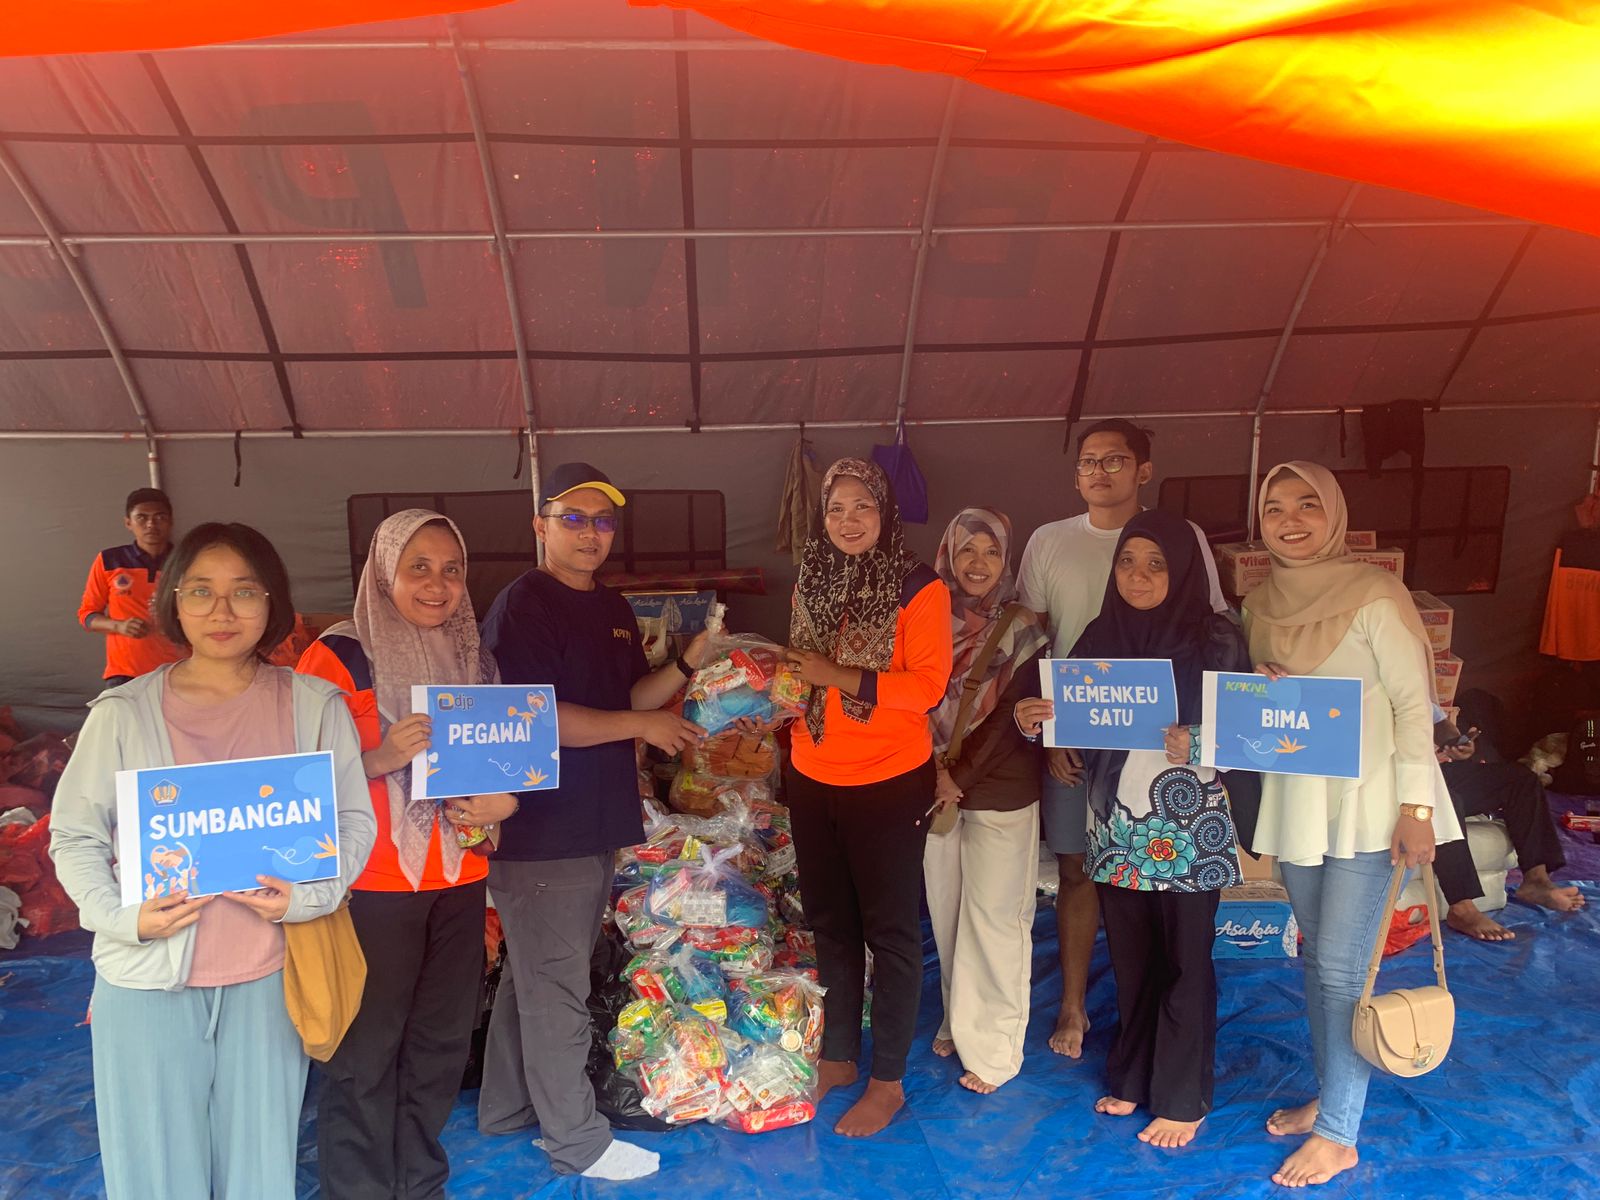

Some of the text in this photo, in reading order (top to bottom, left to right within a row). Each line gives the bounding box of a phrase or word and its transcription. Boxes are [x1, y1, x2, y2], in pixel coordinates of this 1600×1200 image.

[454, 693, 474, 711] djp
[1063, 685, 1159, 704] KEMENKEU
[1089, 708, 1133, 727] SATU
[1261, 708, 1310, 730] BIMA
[448, 720, 531, 745] PEGAWAI
[149, 797, 322, 841] SUMBANGAN
[1215, 919, 1282, 940] Asakota
